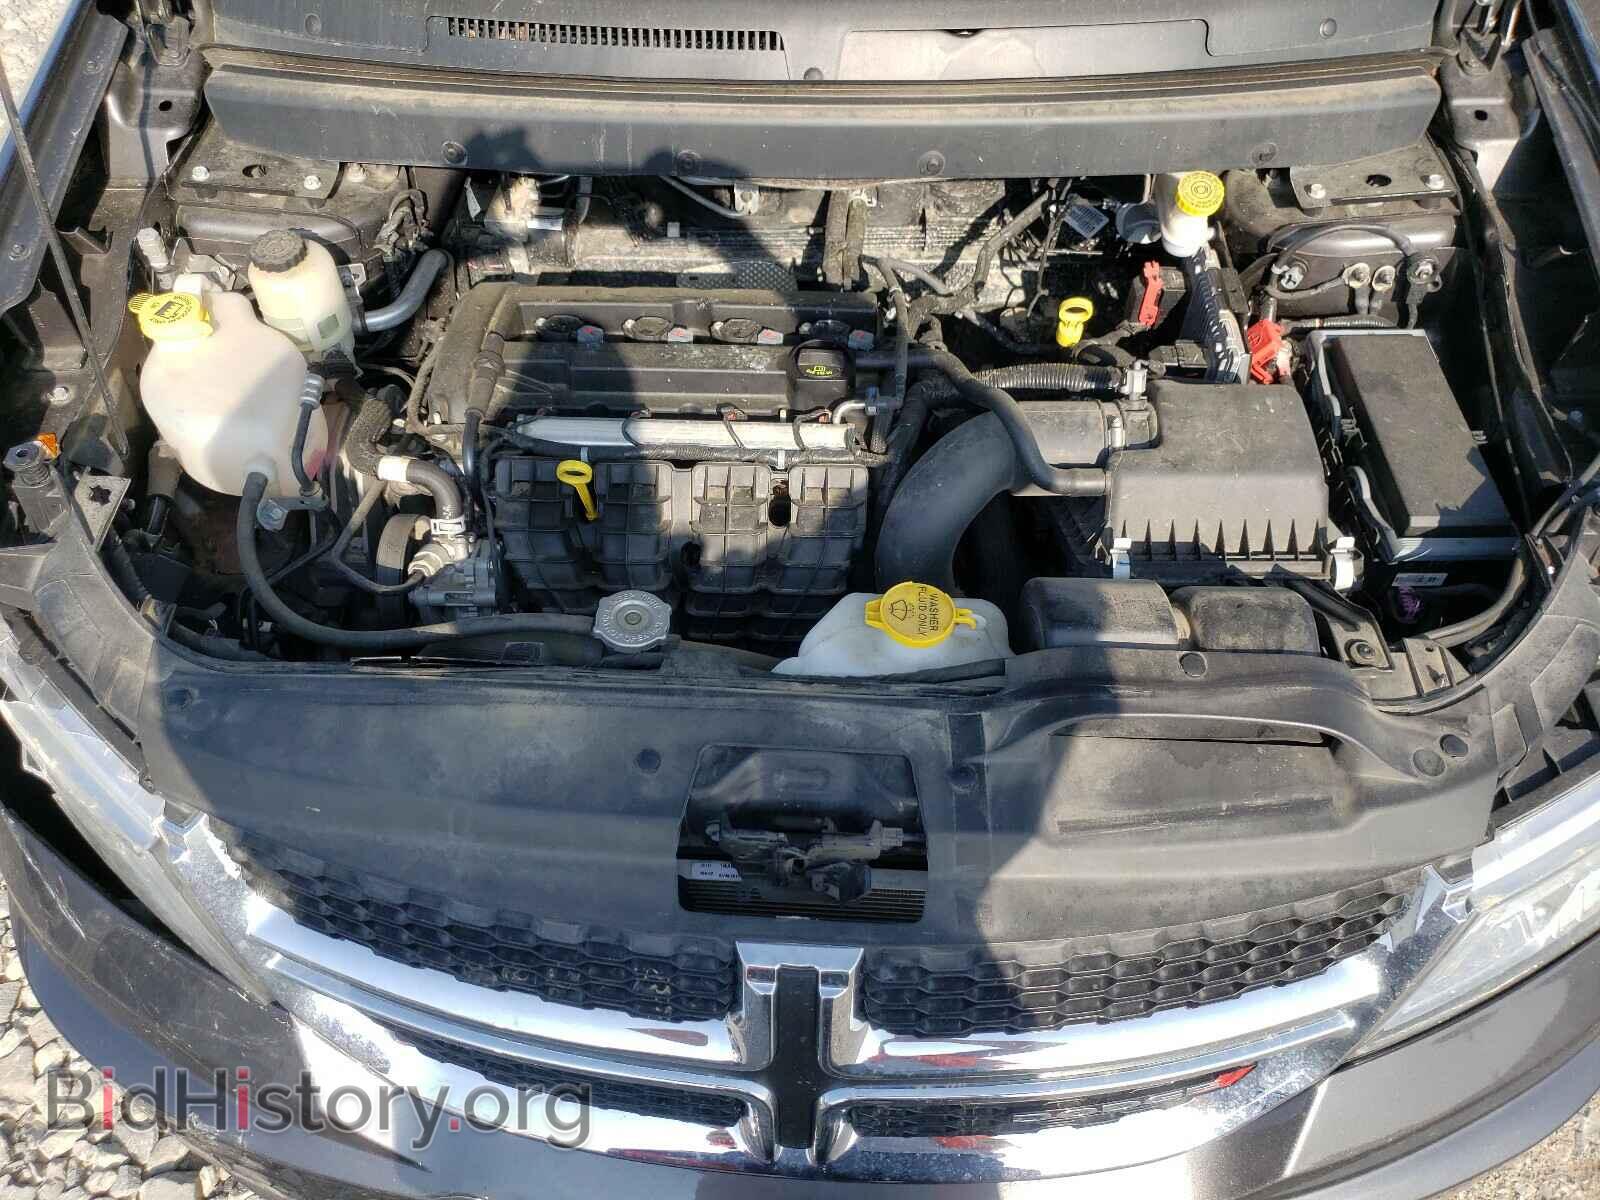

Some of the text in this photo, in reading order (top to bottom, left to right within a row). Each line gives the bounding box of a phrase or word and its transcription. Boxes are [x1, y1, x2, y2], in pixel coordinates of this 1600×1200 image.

[918, 586, 928, 639] FLUID ONLY
[929, 593, 939, 632] WASHER
